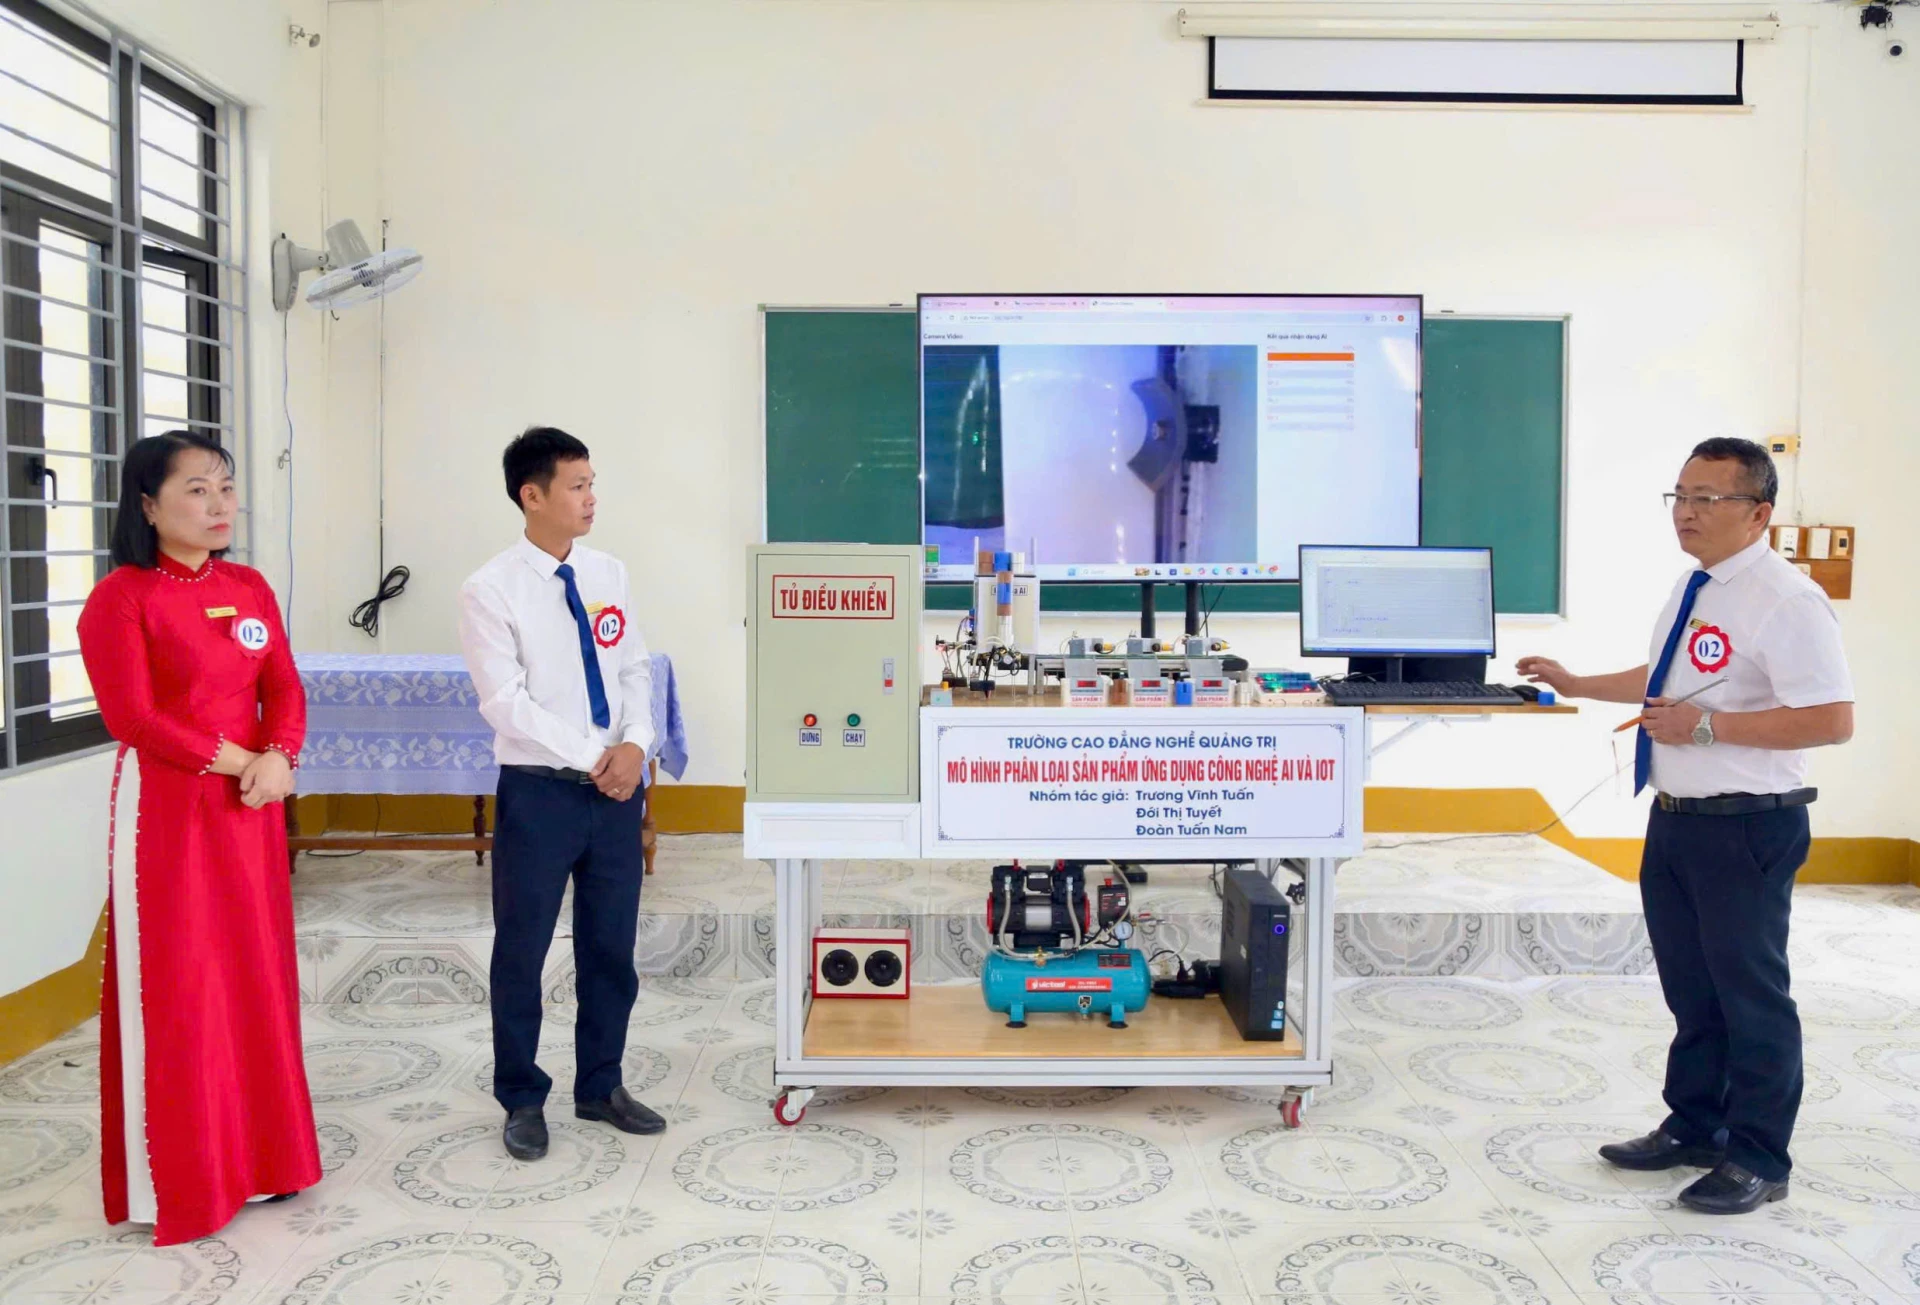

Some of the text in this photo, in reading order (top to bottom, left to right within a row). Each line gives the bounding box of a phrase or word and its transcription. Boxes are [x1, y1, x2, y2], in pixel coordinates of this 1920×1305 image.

[780, 581, 887, 611] TỦ ĐIỀU KHIỂN
[242, 625, 264, 643] 02
[601, 619, 617, 637] 02
[1698, 640, 1720, 658] 02
[1008, 730, 1277, 751] TRƯỜNG CAO ĐẲNG NGHỀ QUẢNG TRỊ
[948, 751, 1335, 787] MÔ HÌNH PHÂN LOẠI SẢN PHẨM ỨNG DỤNG CÔNG NGHỆ AI VÀ IOT
[1030, 788, 1129, 804] Nhóm tác giả:
[1136, 787, 1254, 804] Trương Vĩnh Tuấn
[1136, 804, 1222, 821] Đới Thị Tuyết
[1136, 822, 1247, 836] Đoàn Tuấn Nam
